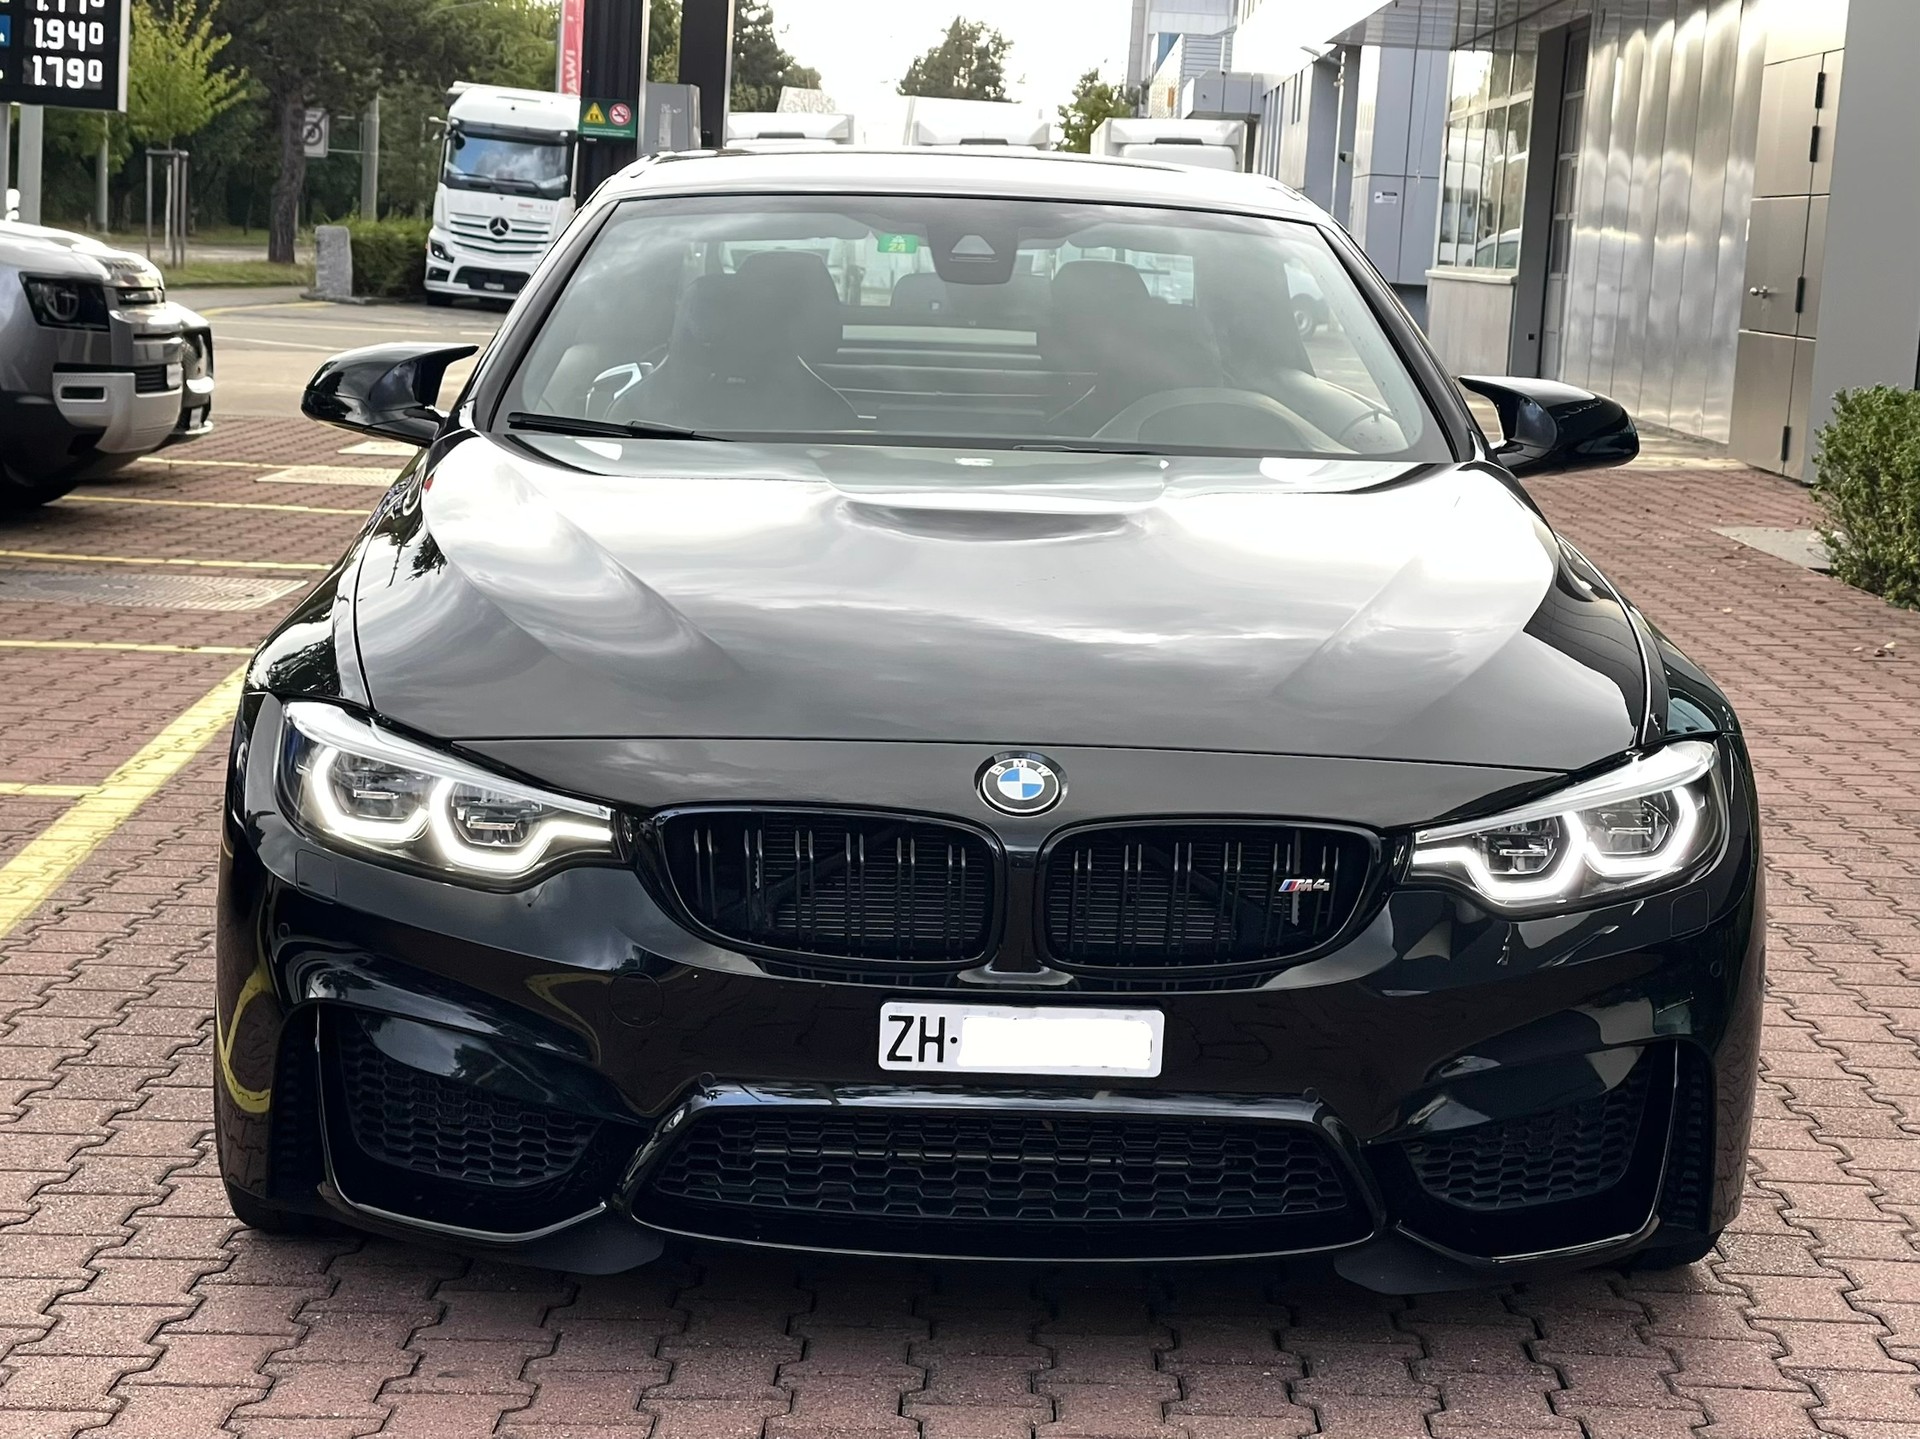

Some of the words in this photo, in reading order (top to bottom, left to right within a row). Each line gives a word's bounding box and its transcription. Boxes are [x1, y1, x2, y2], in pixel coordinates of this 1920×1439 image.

[565, 49, 578, 97] AWI
[989, 759, 1053, 777] BMW
[1279, 878, 1330, 893] M4
